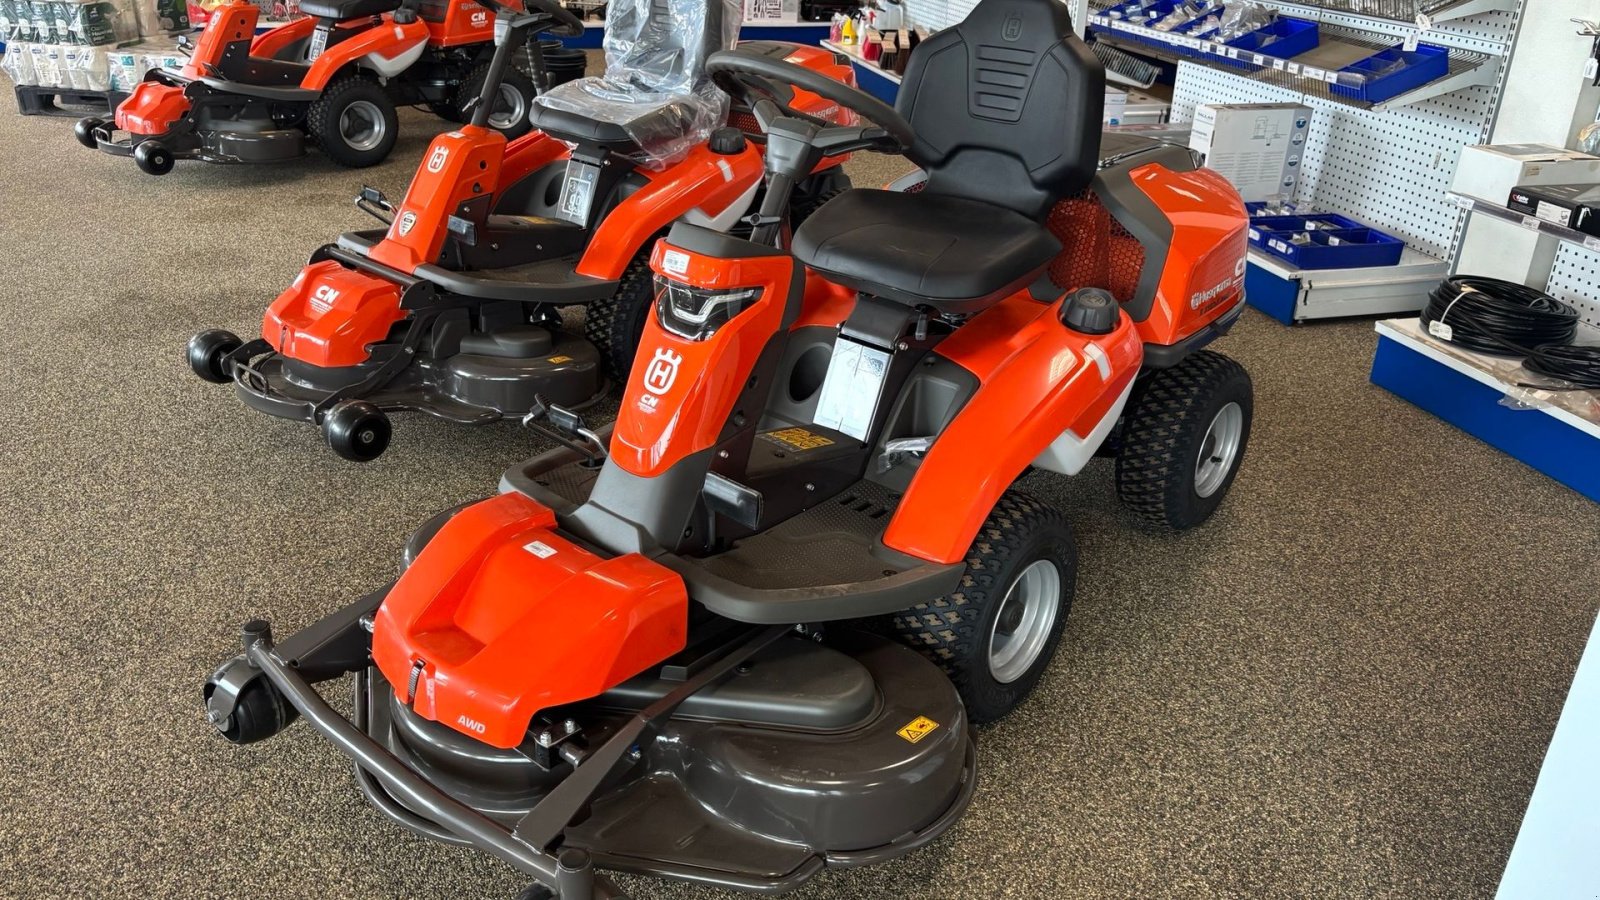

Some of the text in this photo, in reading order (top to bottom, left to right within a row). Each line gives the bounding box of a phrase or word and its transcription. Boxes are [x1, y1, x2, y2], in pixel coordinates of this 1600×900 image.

[471, 12, 486, 22] CN
[1234, 256, 1246, 277] C
[315, 285, 340, 304] CN
[640, 393, 659, 407] CN
[457, 715, 486, 734] AWD
